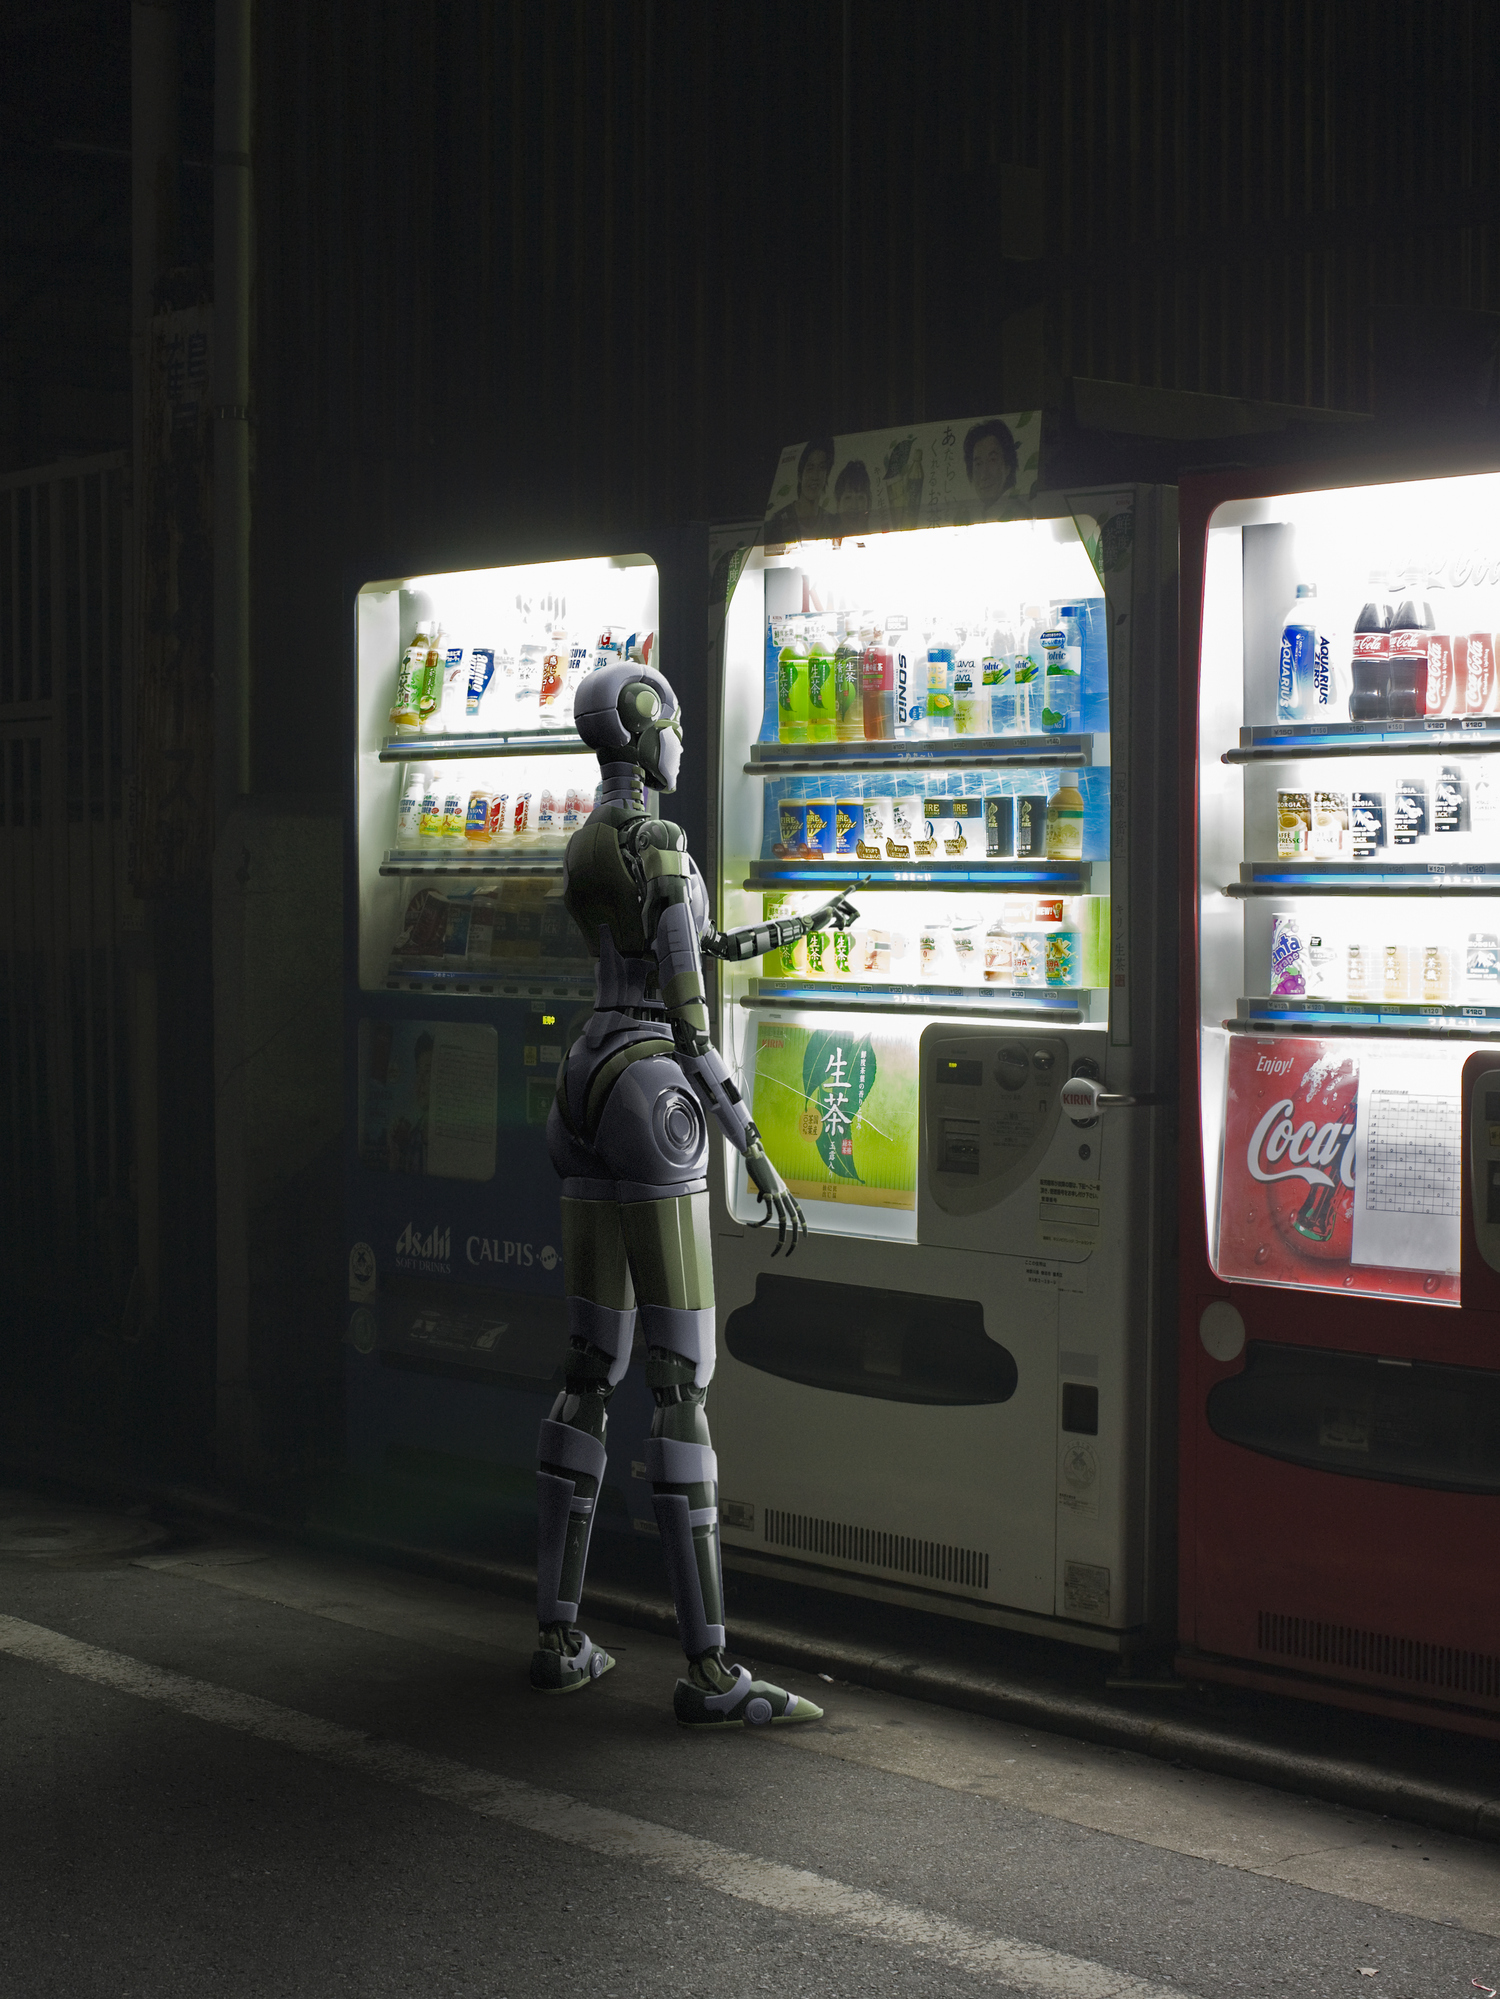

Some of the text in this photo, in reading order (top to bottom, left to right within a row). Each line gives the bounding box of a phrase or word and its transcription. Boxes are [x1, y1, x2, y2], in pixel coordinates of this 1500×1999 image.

[473, 654, 489, 693] amino
[845, 662, 857, 683] 生茶
[956, 660, 976, 668] ava
[1015, 661, 1029, 670] olvic
[1279, 638, 1292, 709] AQUARIUS
[1313, 652, 1321, 689] ZERO
[1319, 635, 1331, 705] AQUARIUS
[810, 664, 821, 695] 生茶
[955, 674, 972, 682] ava
[924, 804, 940, 813] FIRE
[1036, 907, 1053, 916] NEW!
[810, 935, 820, 961] 生茶
[836, 935, 848, 961] 生茶
[1114, 905, 1126, 973] キリン生茶
[1272, 935, 1303, 965] anta
[1274, 952, 1300, 975] Grape
[762, 1039, 784, 1049] KIRIN
[1256, 1056, 1295, 1076] Enjoy!
[821, 1047, 853, 1137] 生茶
[1062, 1094, 1092, 1106] KIRIN
[828, 1141, 837, 1179] 玉露入り
[396, 1221, 452, 1261] Asahi
[466, 1236, 534, 1267] CALPIS
[395, 1257, 452, 1275] SOFT DRINKS
